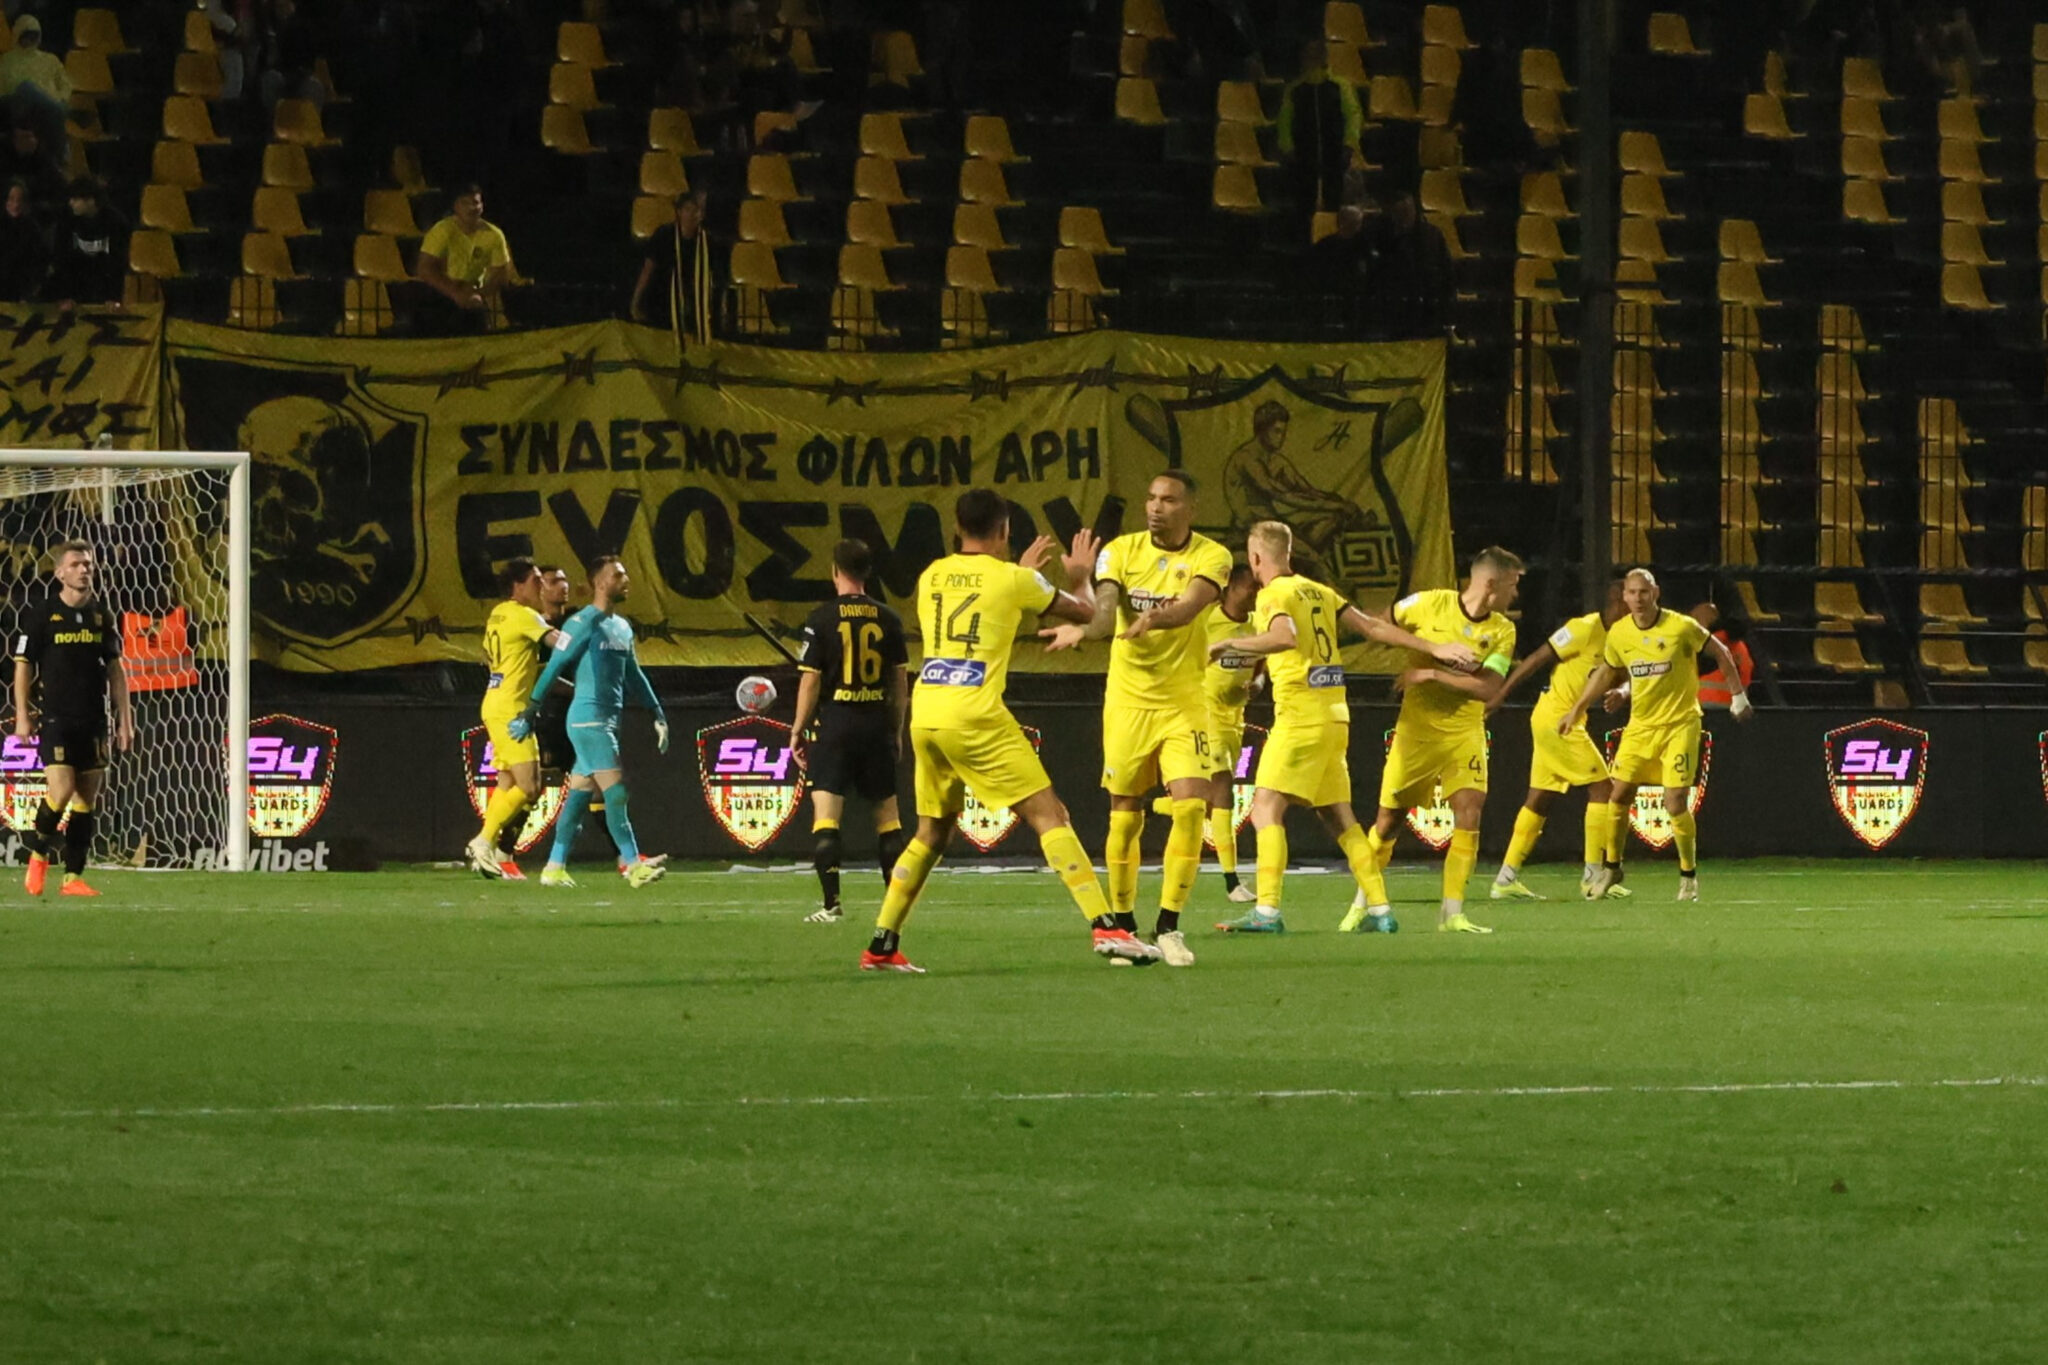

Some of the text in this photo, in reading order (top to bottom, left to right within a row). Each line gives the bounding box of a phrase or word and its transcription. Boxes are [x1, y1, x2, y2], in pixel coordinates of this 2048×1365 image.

[458, 419, 1100, 486] ΣΥΝΔΕΣΜΟΣ ΦΙΛΩΝ ΑΡΗ
[281, 579, 357, 607] 1990
[945, 573, 983, 588] PONCE
[931, 593, 981, 659] 14
[1311, 607, 1332, 664] 6
[838, 621, 884, 685] 16
[833, 687, 884, 702] novibet
[1190, 729, 1210, 756] 18
[714, 738, 793, 780] S4
[1468, 754, 1482, 775] 4
[1673, 753, 1689, 773] 21
[1840, 740, 1913, 780] S4
[1851, 799, 1904, 810] UARDS
